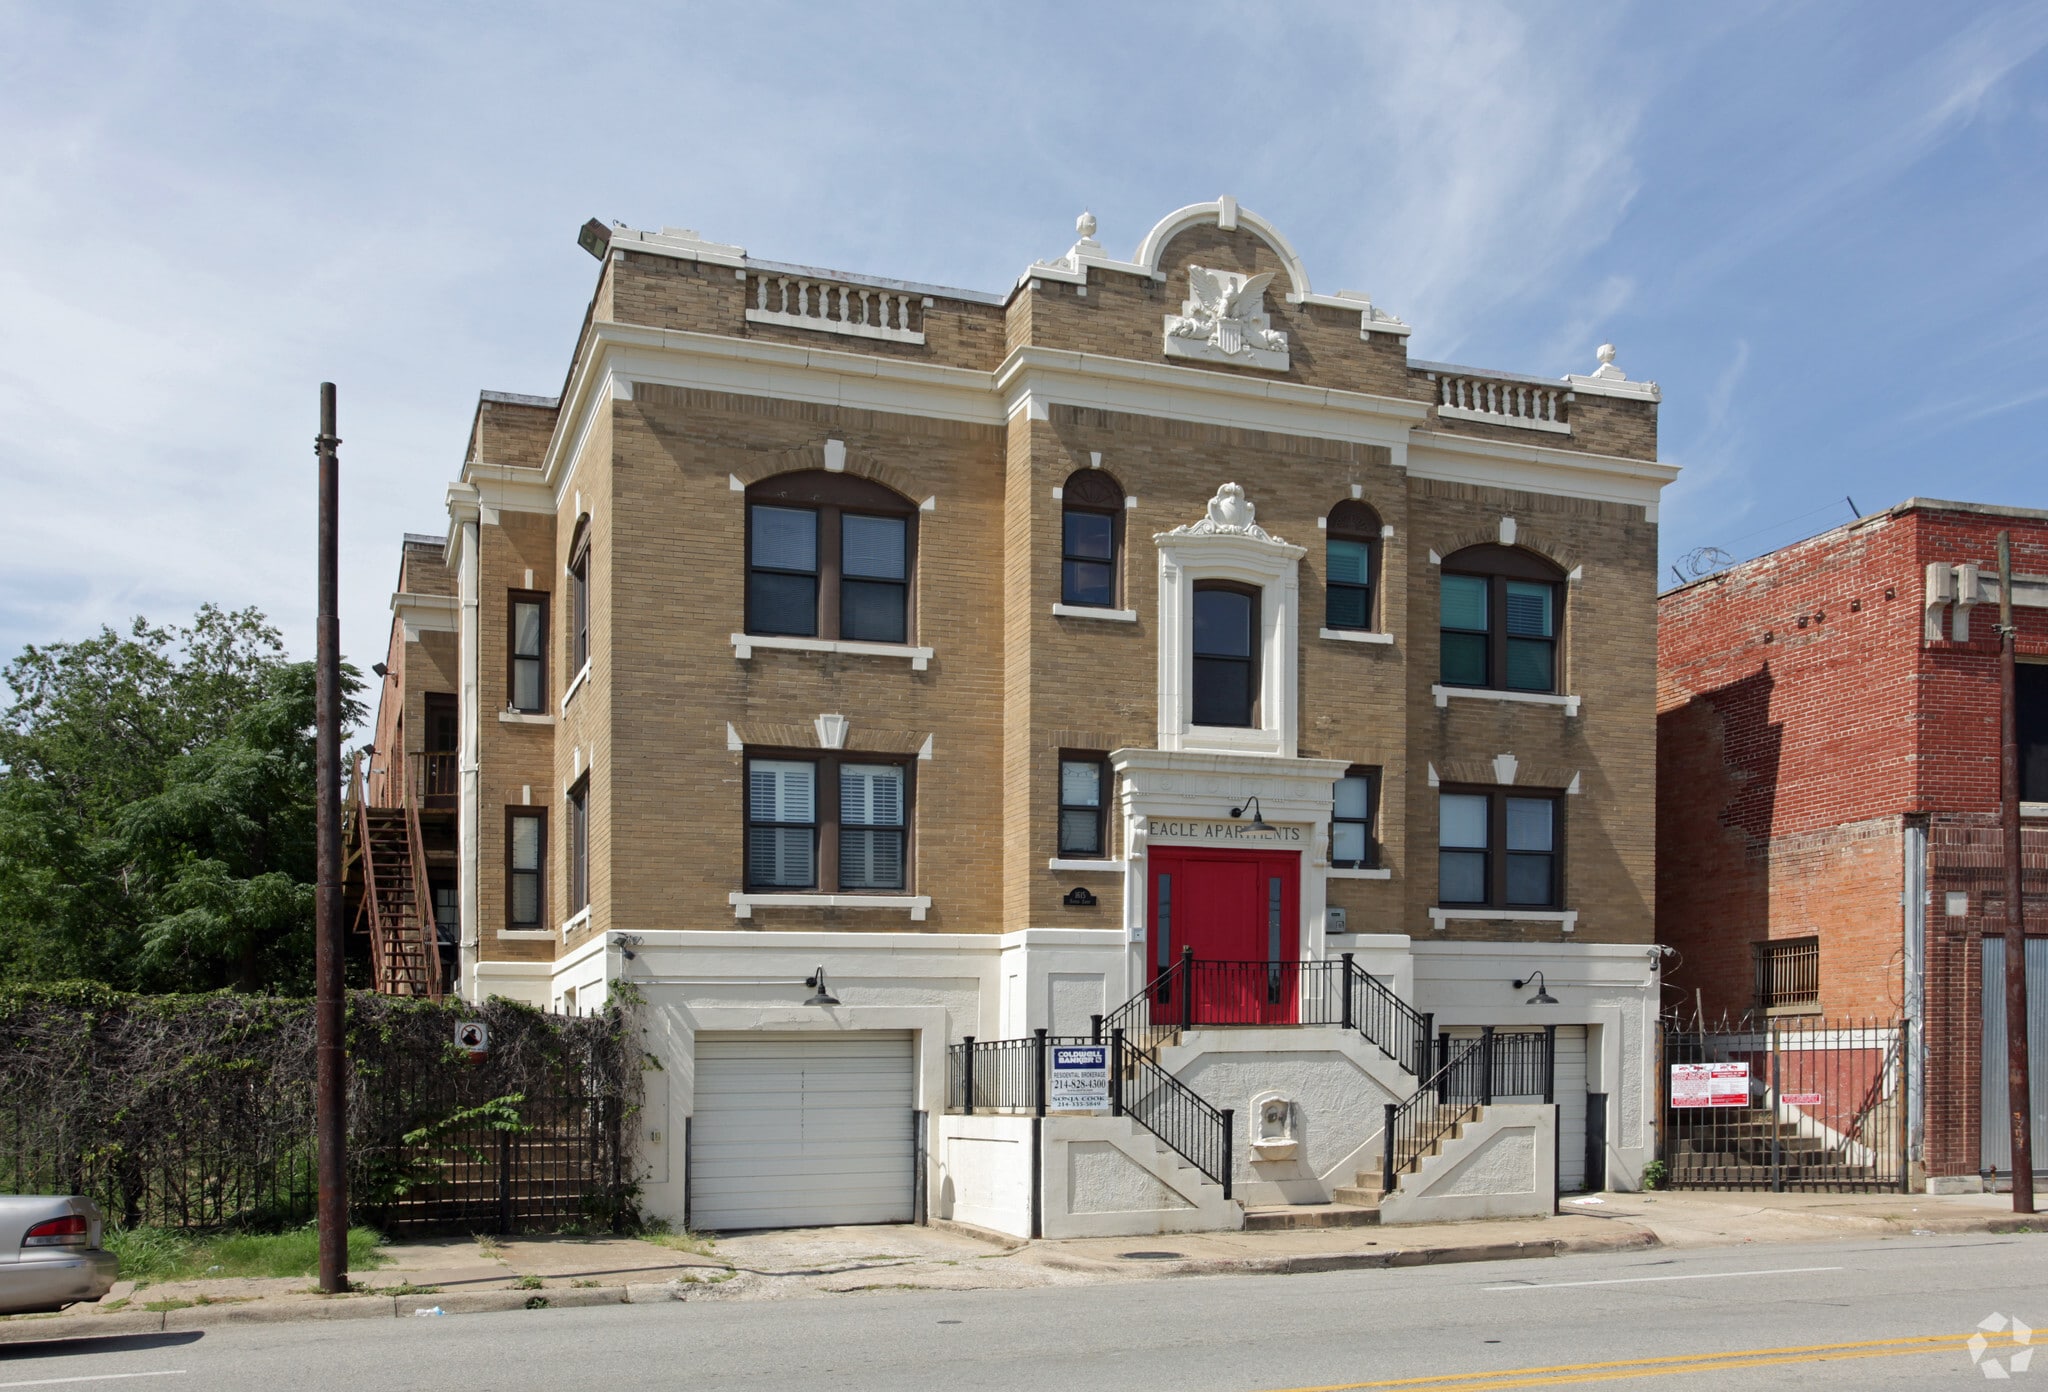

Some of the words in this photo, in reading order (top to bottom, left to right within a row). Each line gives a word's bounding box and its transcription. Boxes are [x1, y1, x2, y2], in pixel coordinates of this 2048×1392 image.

[1149, 821, 1199, 837] EAGLE
[1204, 824, 1300, 841] APARNTS
[1054, 1079, 1106, 1089] 214-828-4300
